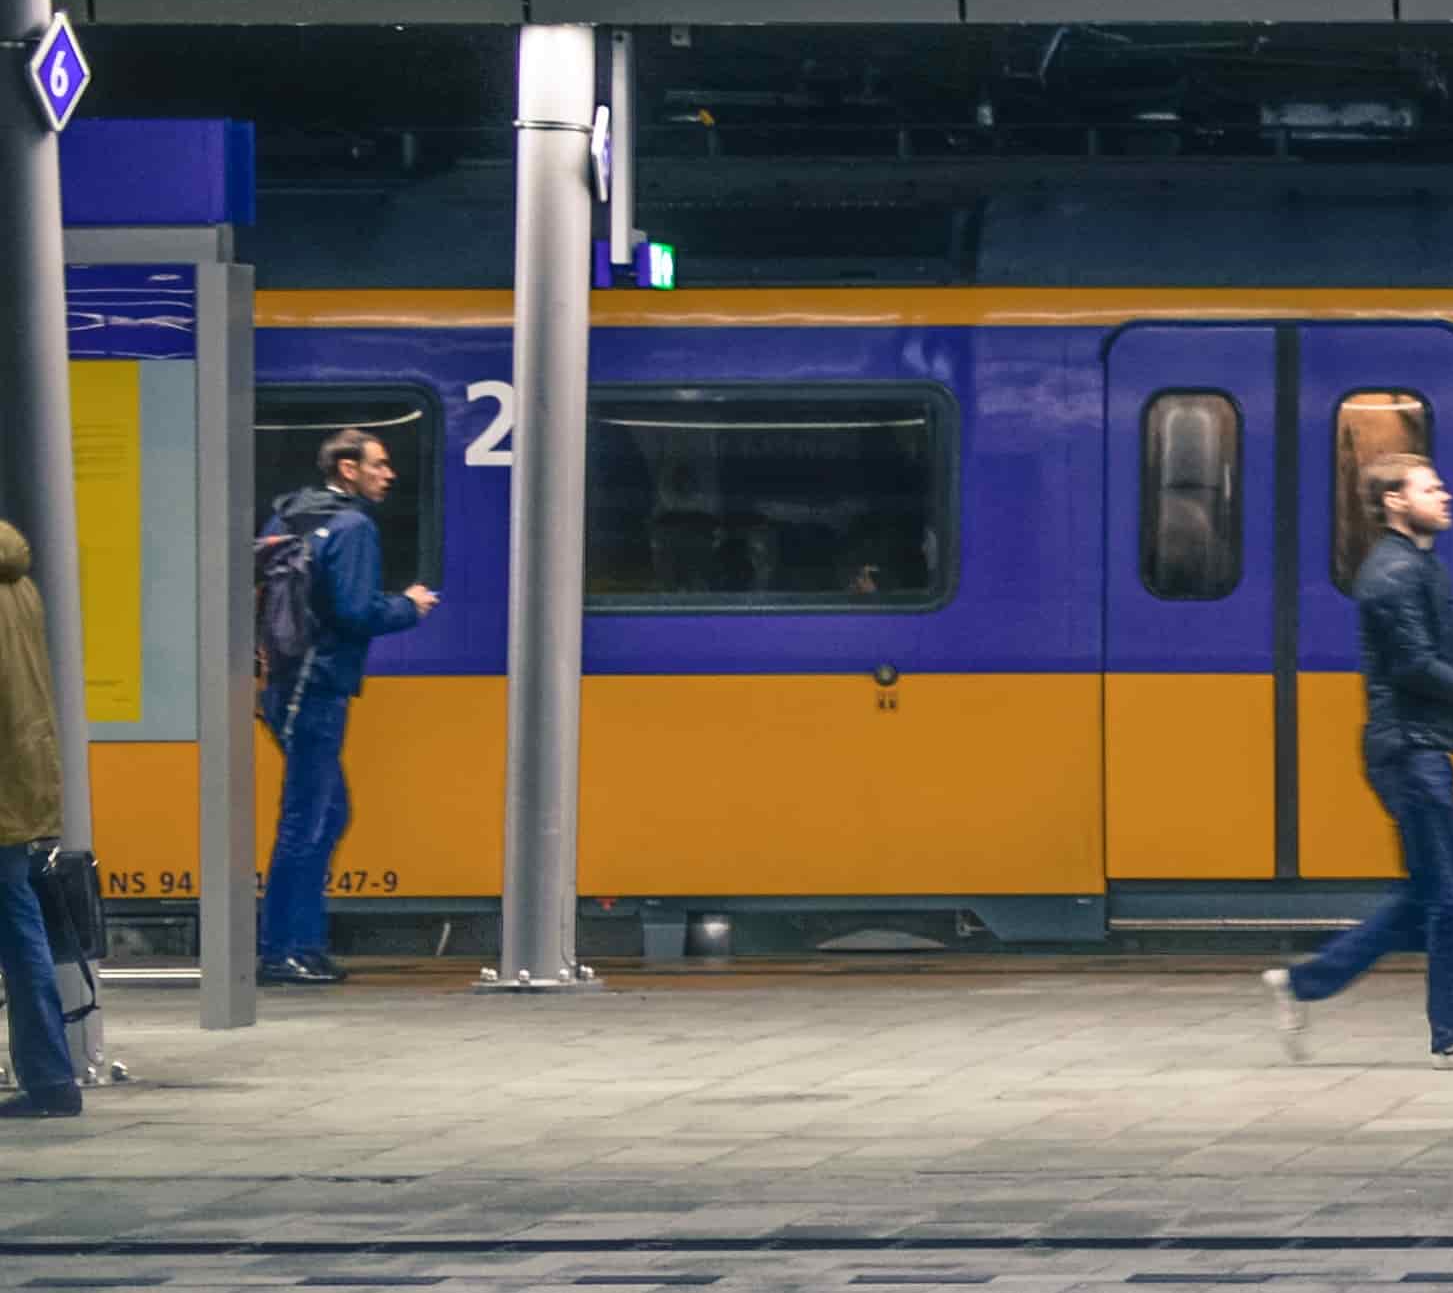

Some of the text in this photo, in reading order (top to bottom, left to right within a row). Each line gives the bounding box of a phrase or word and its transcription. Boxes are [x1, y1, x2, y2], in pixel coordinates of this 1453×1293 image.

[50, 50, 69, 97] 6
[464, 379, 513, 467] 2
[108, 870, 146, 893] NS
[159, 870, 193, 893] 94
